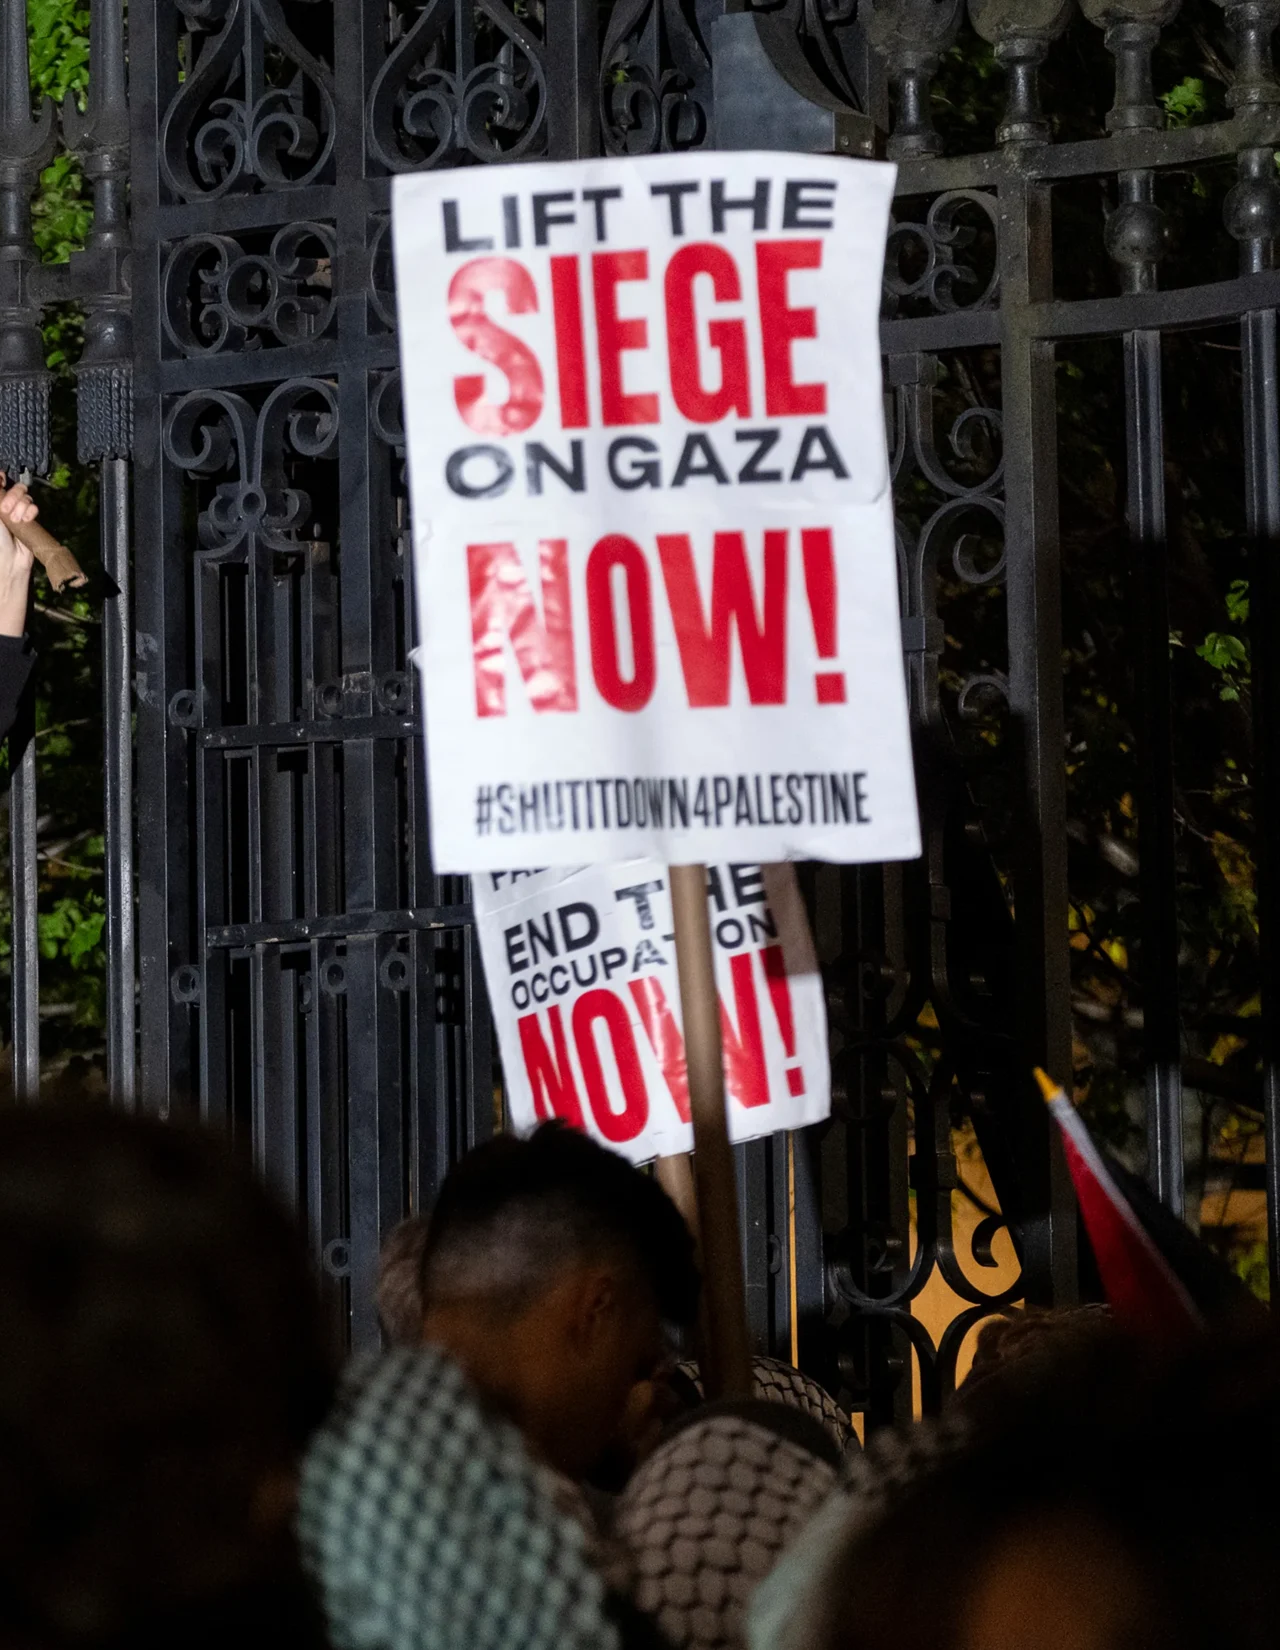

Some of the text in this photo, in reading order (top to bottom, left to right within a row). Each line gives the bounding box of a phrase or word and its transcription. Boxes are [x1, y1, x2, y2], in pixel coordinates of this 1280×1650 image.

[442, 179, 838, 254] LIFT THE
[447, 238, 829, 437] SIEGE
[445, 425, 850, 499] ON GAZA
[466, 527, 848, 718] NOW!
[475, 771, 872, 837] #SHUTITDOWN4PALESTINE
[503, 901, 600, 975] END
[511, 908, 779, 1011] OCCUPAON
[517, 944, 807, 1144] NOW!
